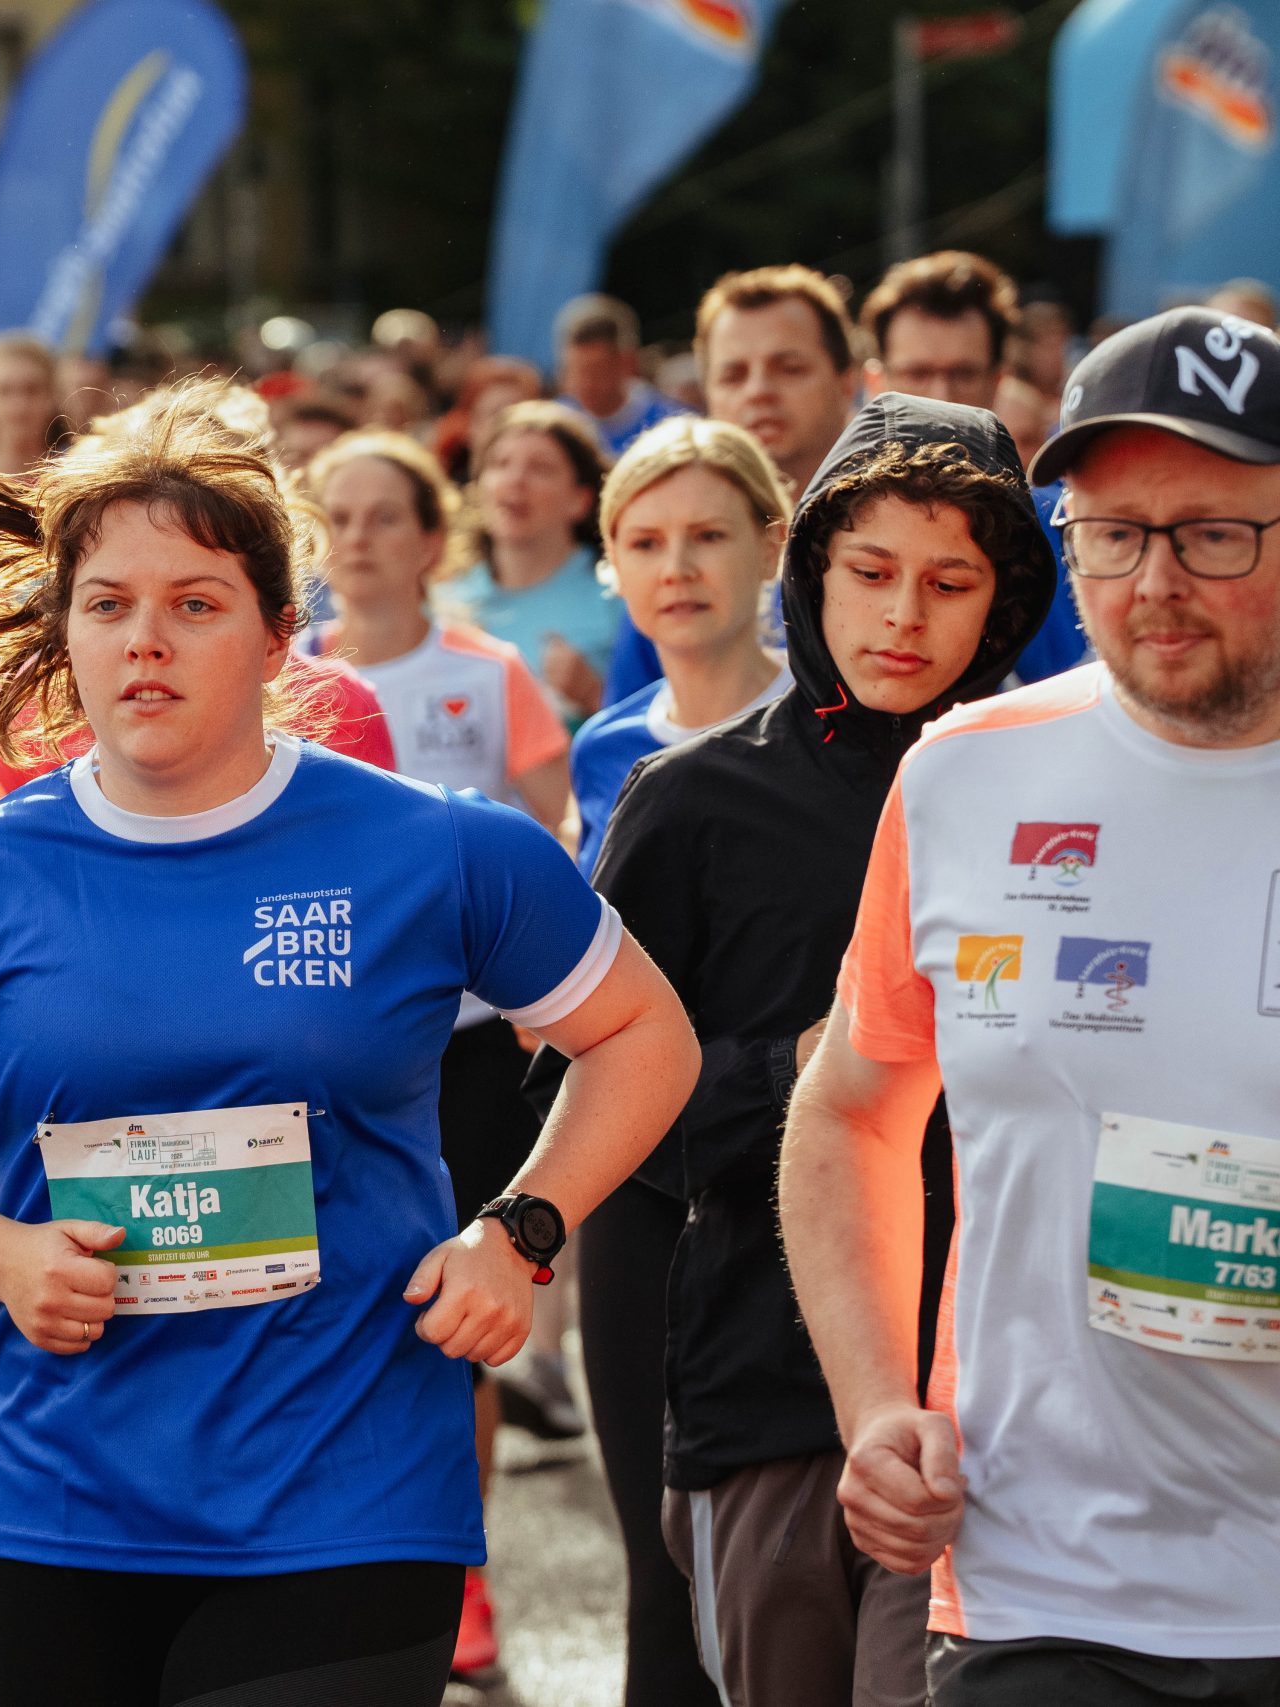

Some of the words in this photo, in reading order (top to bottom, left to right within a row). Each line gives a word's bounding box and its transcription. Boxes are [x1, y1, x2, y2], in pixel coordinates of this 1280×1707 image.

[255, 887, 352, 904] Landeshauptstadt
[254, 899, 352, 929] SAAR
[277, 929, 351, 956] BRÜ
[254, 960, 352, 987] CKEN
[128, 1123, 143, 1132] dm
[130, 1139, 156, 1148] FIRMEN
[131, 1149, 157, 1161] LAUF
[130, 1182, 221, 1223] Katja
[152, 1224, 203, 1246] 8069
[1169, 1204, 1280, 1257] Mark
[148, 1252, 178, 1262] STARTZEIT
[1214, 1260, 1277, 1289] 7763
